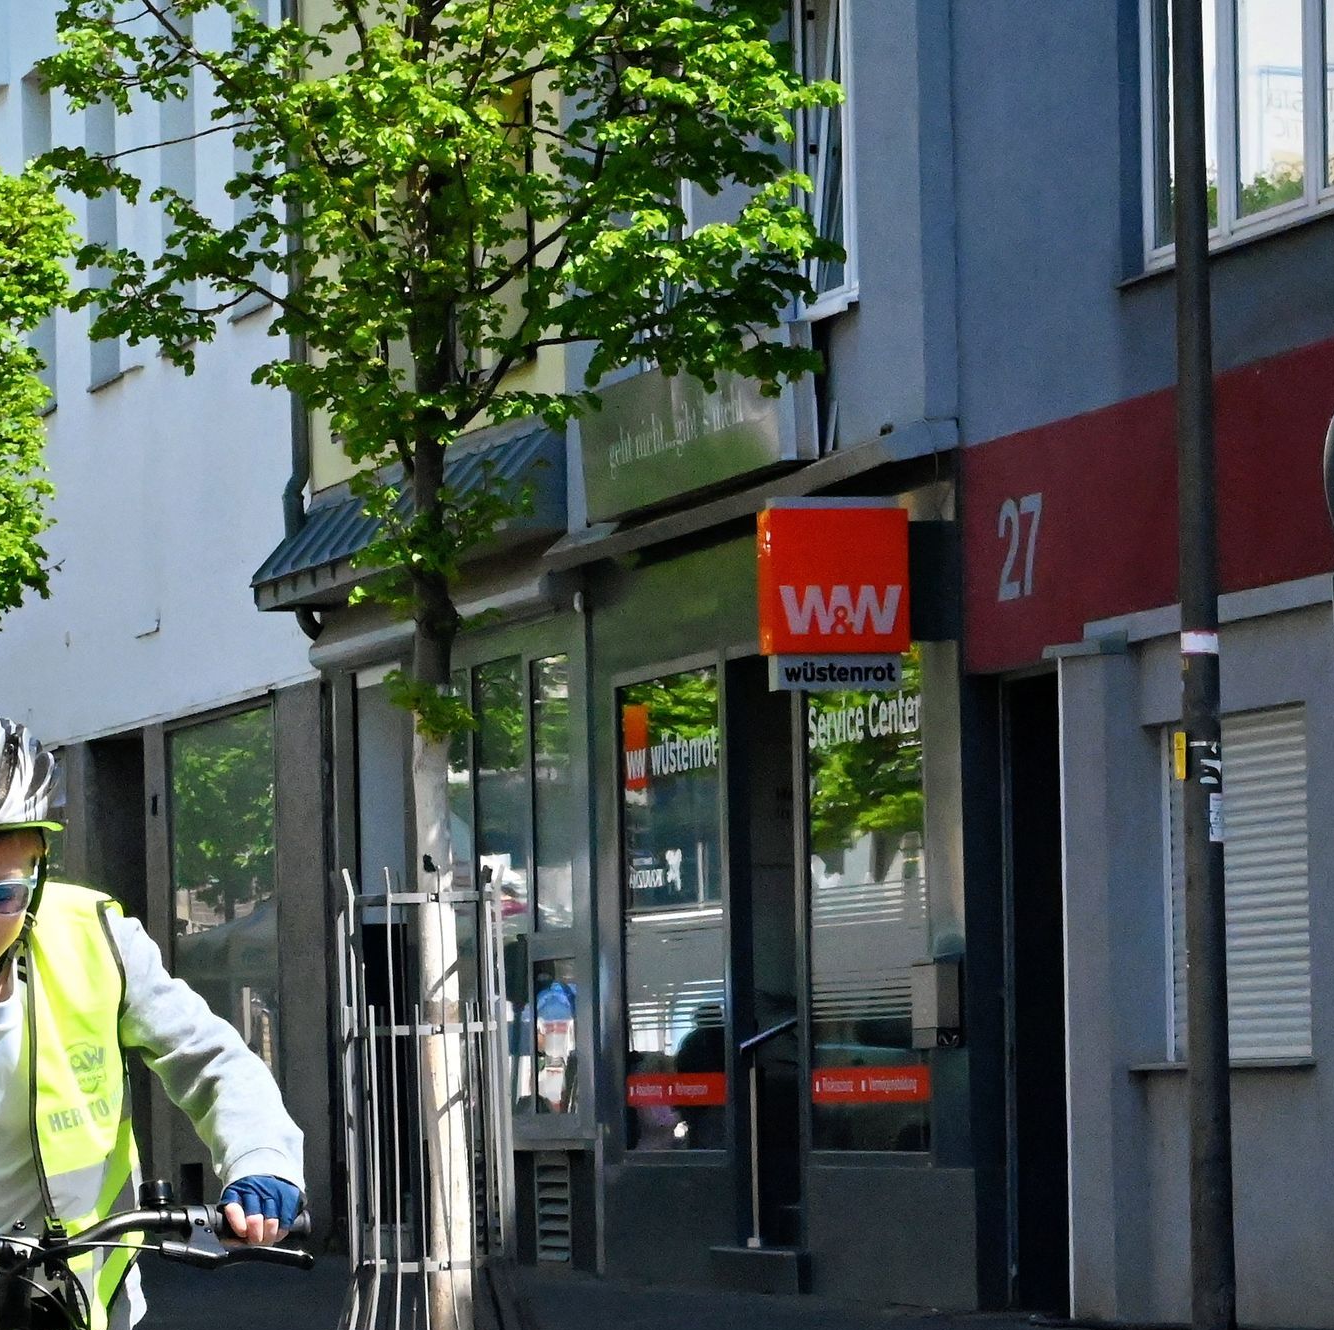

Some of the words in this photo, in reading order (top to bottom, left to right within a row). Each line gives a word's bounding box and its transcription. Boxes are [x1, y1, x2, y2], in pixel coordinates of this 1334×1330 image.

[997, 492, 1042, 602] 27
[779, 585, 902, 634] W&W
[785, 662, 896, 682] wüstenrot
[808, 696, 864, 750] Service
[868, 690, 922, 738] Center
[651, 725, 717, 776] wüstenrot
[48, 1107, 84, 1133] HER
